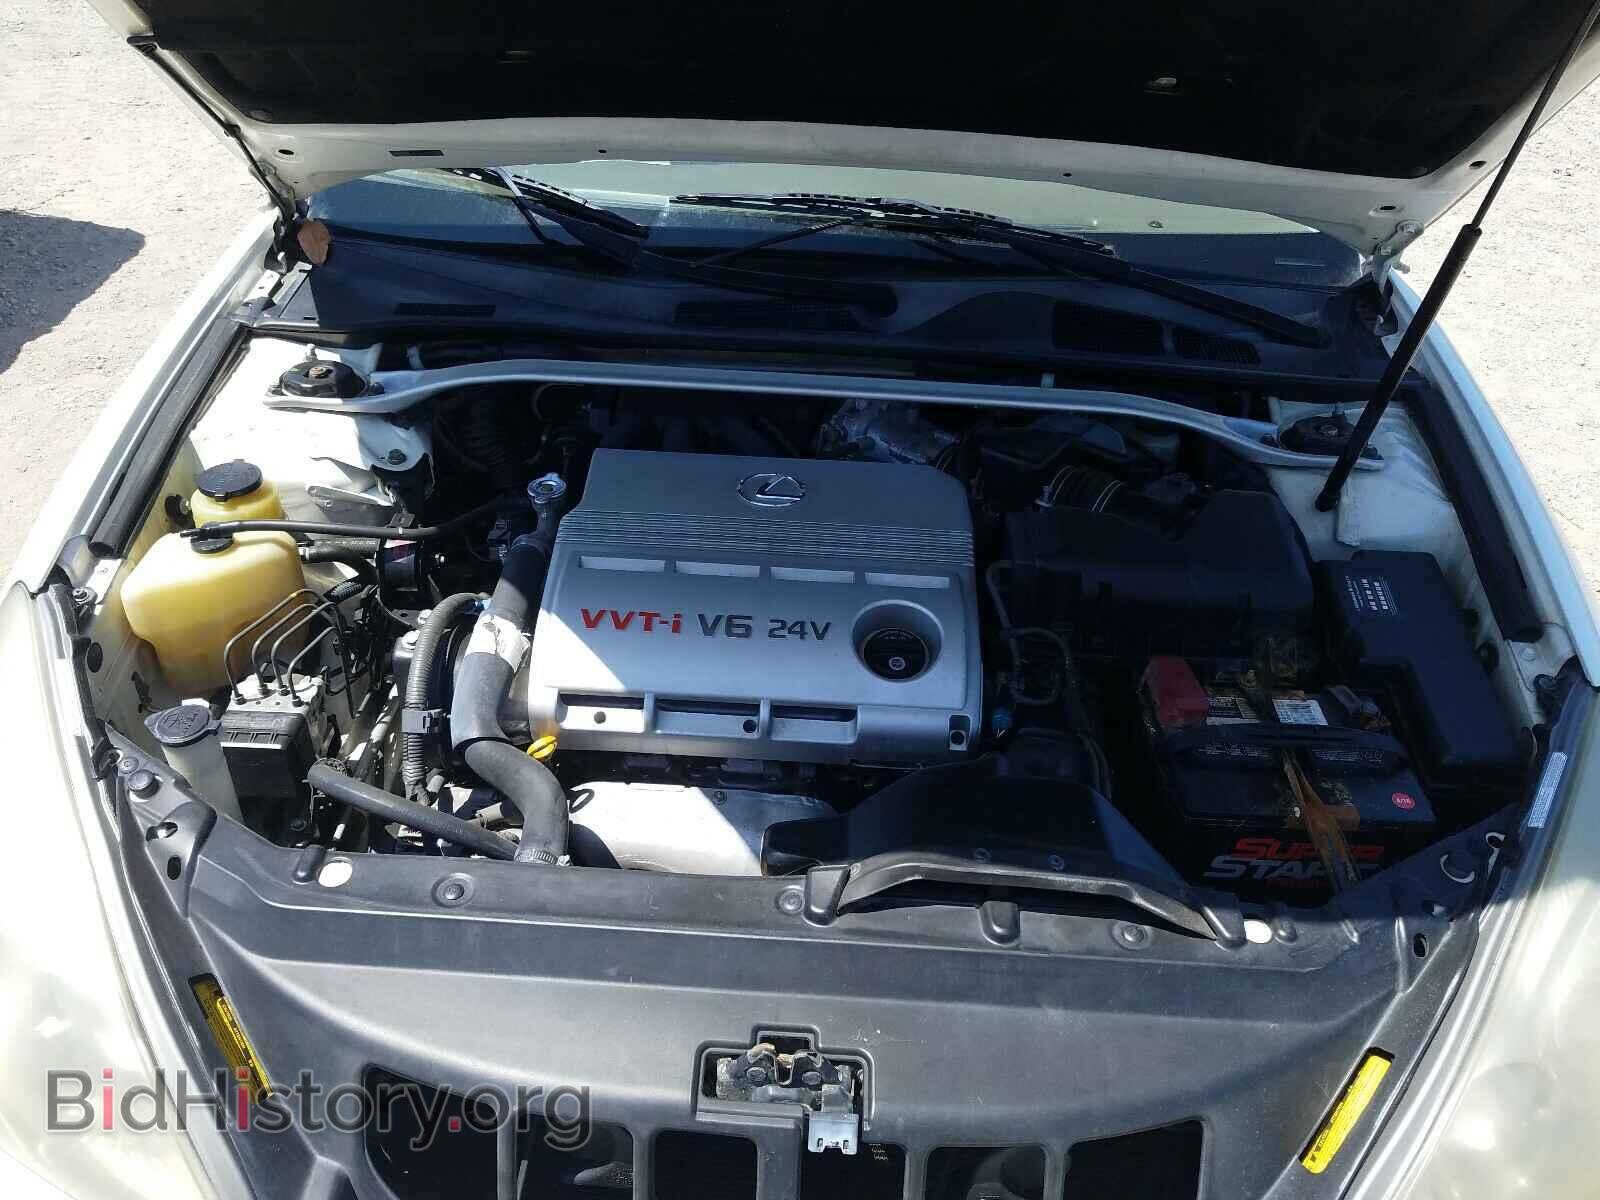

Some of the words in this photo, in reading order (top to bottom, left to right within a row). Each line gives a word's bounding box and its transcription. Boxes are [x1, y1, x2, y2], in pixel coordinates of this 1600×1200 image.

[580, 608, 683, 634] VVT-i
[696, 613, 753, 639] V6
[767, 618, 832, 641] 24V
